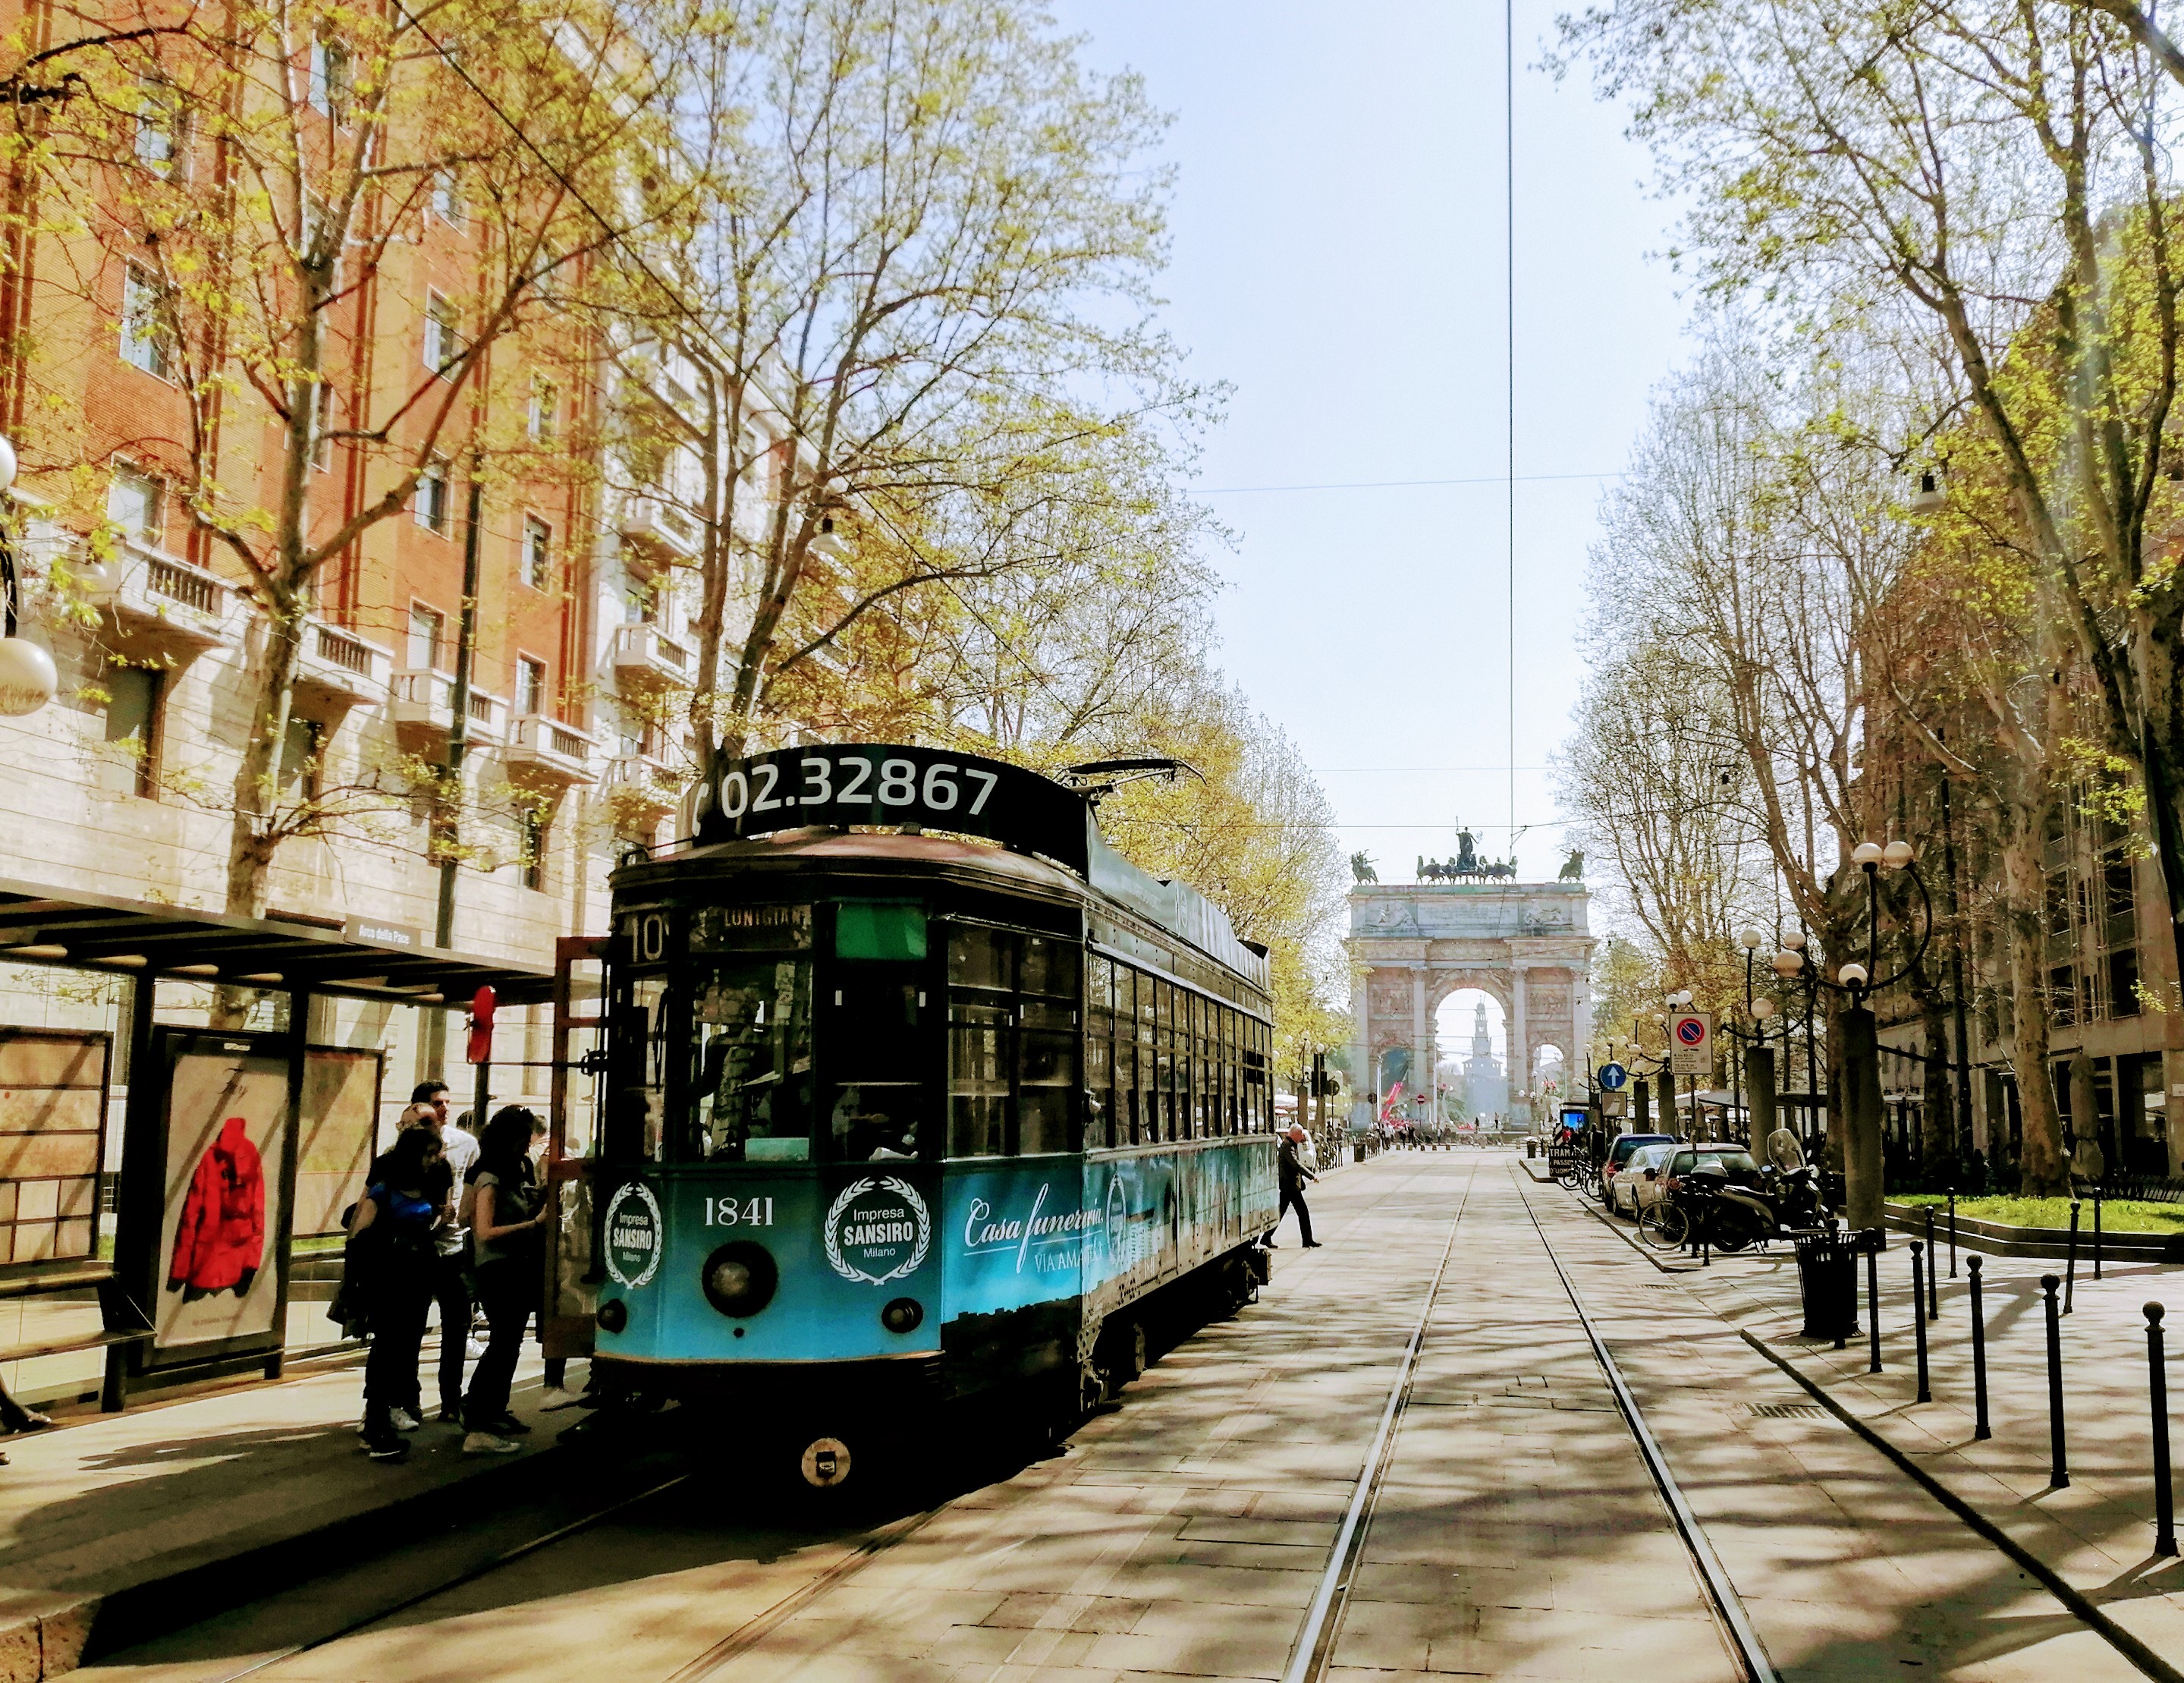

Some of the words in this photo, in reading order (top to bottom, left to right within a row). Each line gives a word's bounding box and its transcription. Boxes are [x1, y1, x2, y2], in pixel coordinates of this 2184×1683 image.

[721, 757, 998, 819] 02.32867
[632, 914, 663, 962] 10
[1549, 1148, 1570, 1157] TRAM
[619, 1212, 649, 1227] Impresa
[705, 1197, 774, 1226] 1841
[853, 1208, 905, 1223] Impresa
[964, 1197, 1022, 1247] Casa
[612, 1227, 652, 1250] SANSIRO
[844, 1221, 913, 1247] SANSIRO
[863, 1247, 896, 1259] Milano
[1034, 1251, 1056, 1274] VIA
